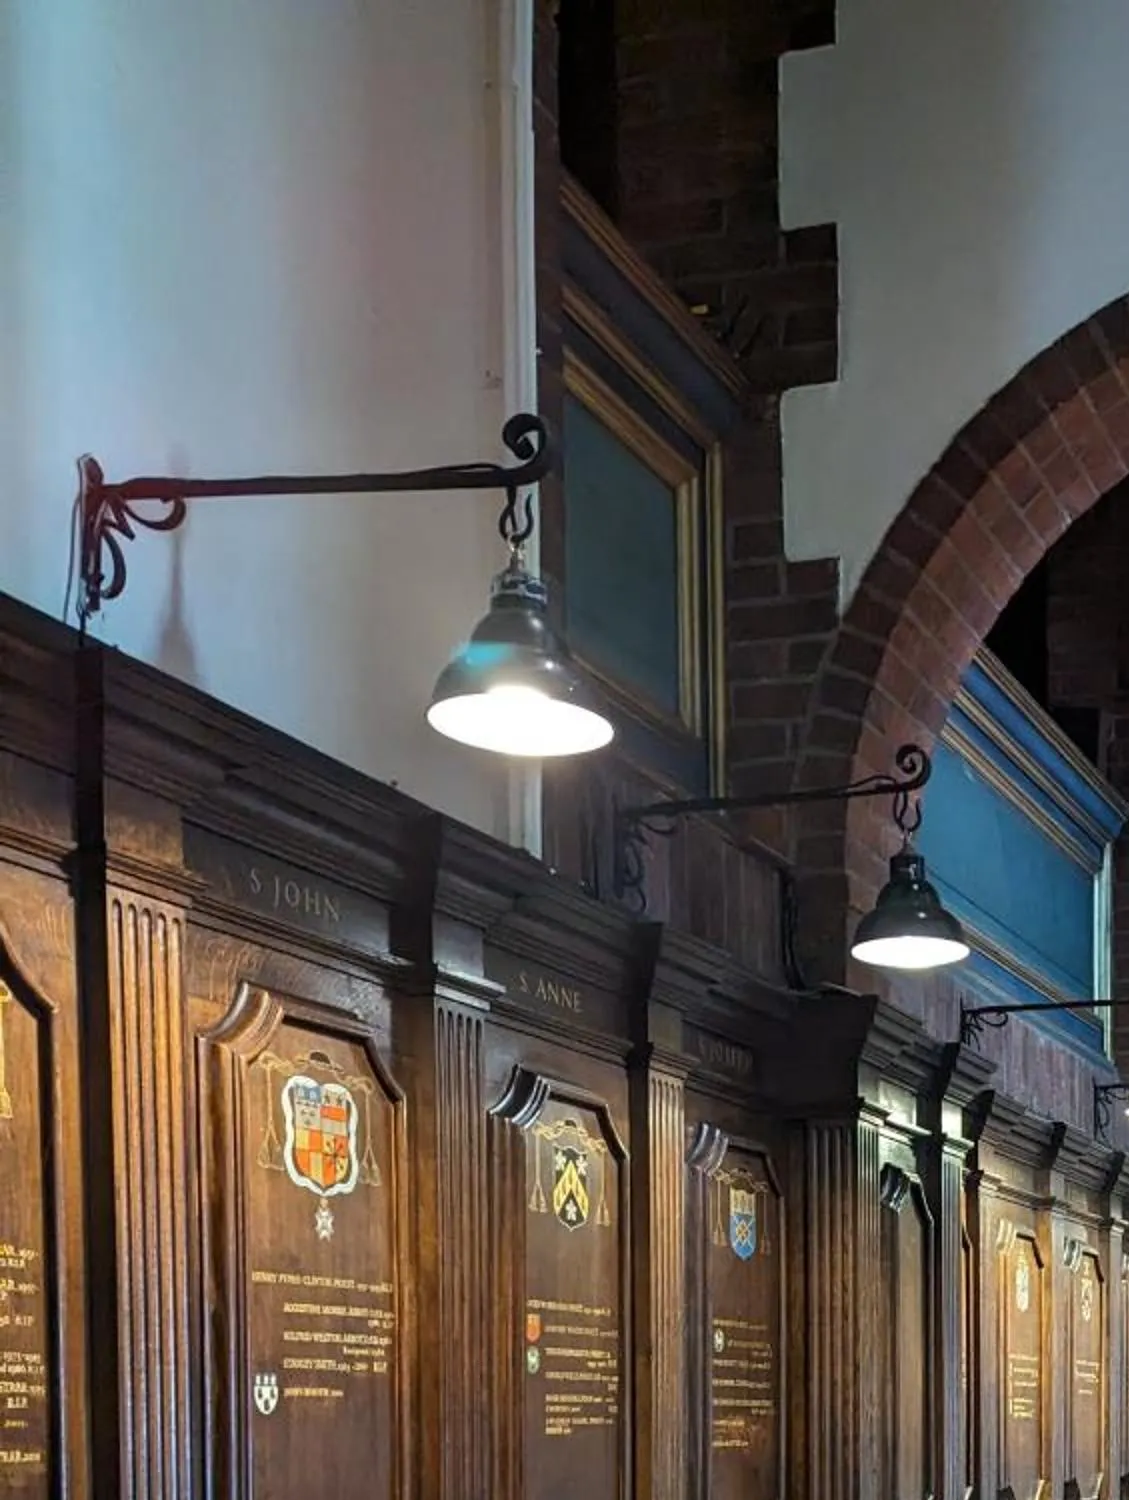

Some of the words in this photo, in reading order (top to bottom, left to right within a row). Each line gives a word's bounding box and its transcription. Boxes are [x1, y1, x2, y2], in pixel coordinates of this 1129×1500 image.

[250, 866, 262, 895] S
[272, 873, 341, 923] JOHN
[535, 977, 583, 1013] ANNE
